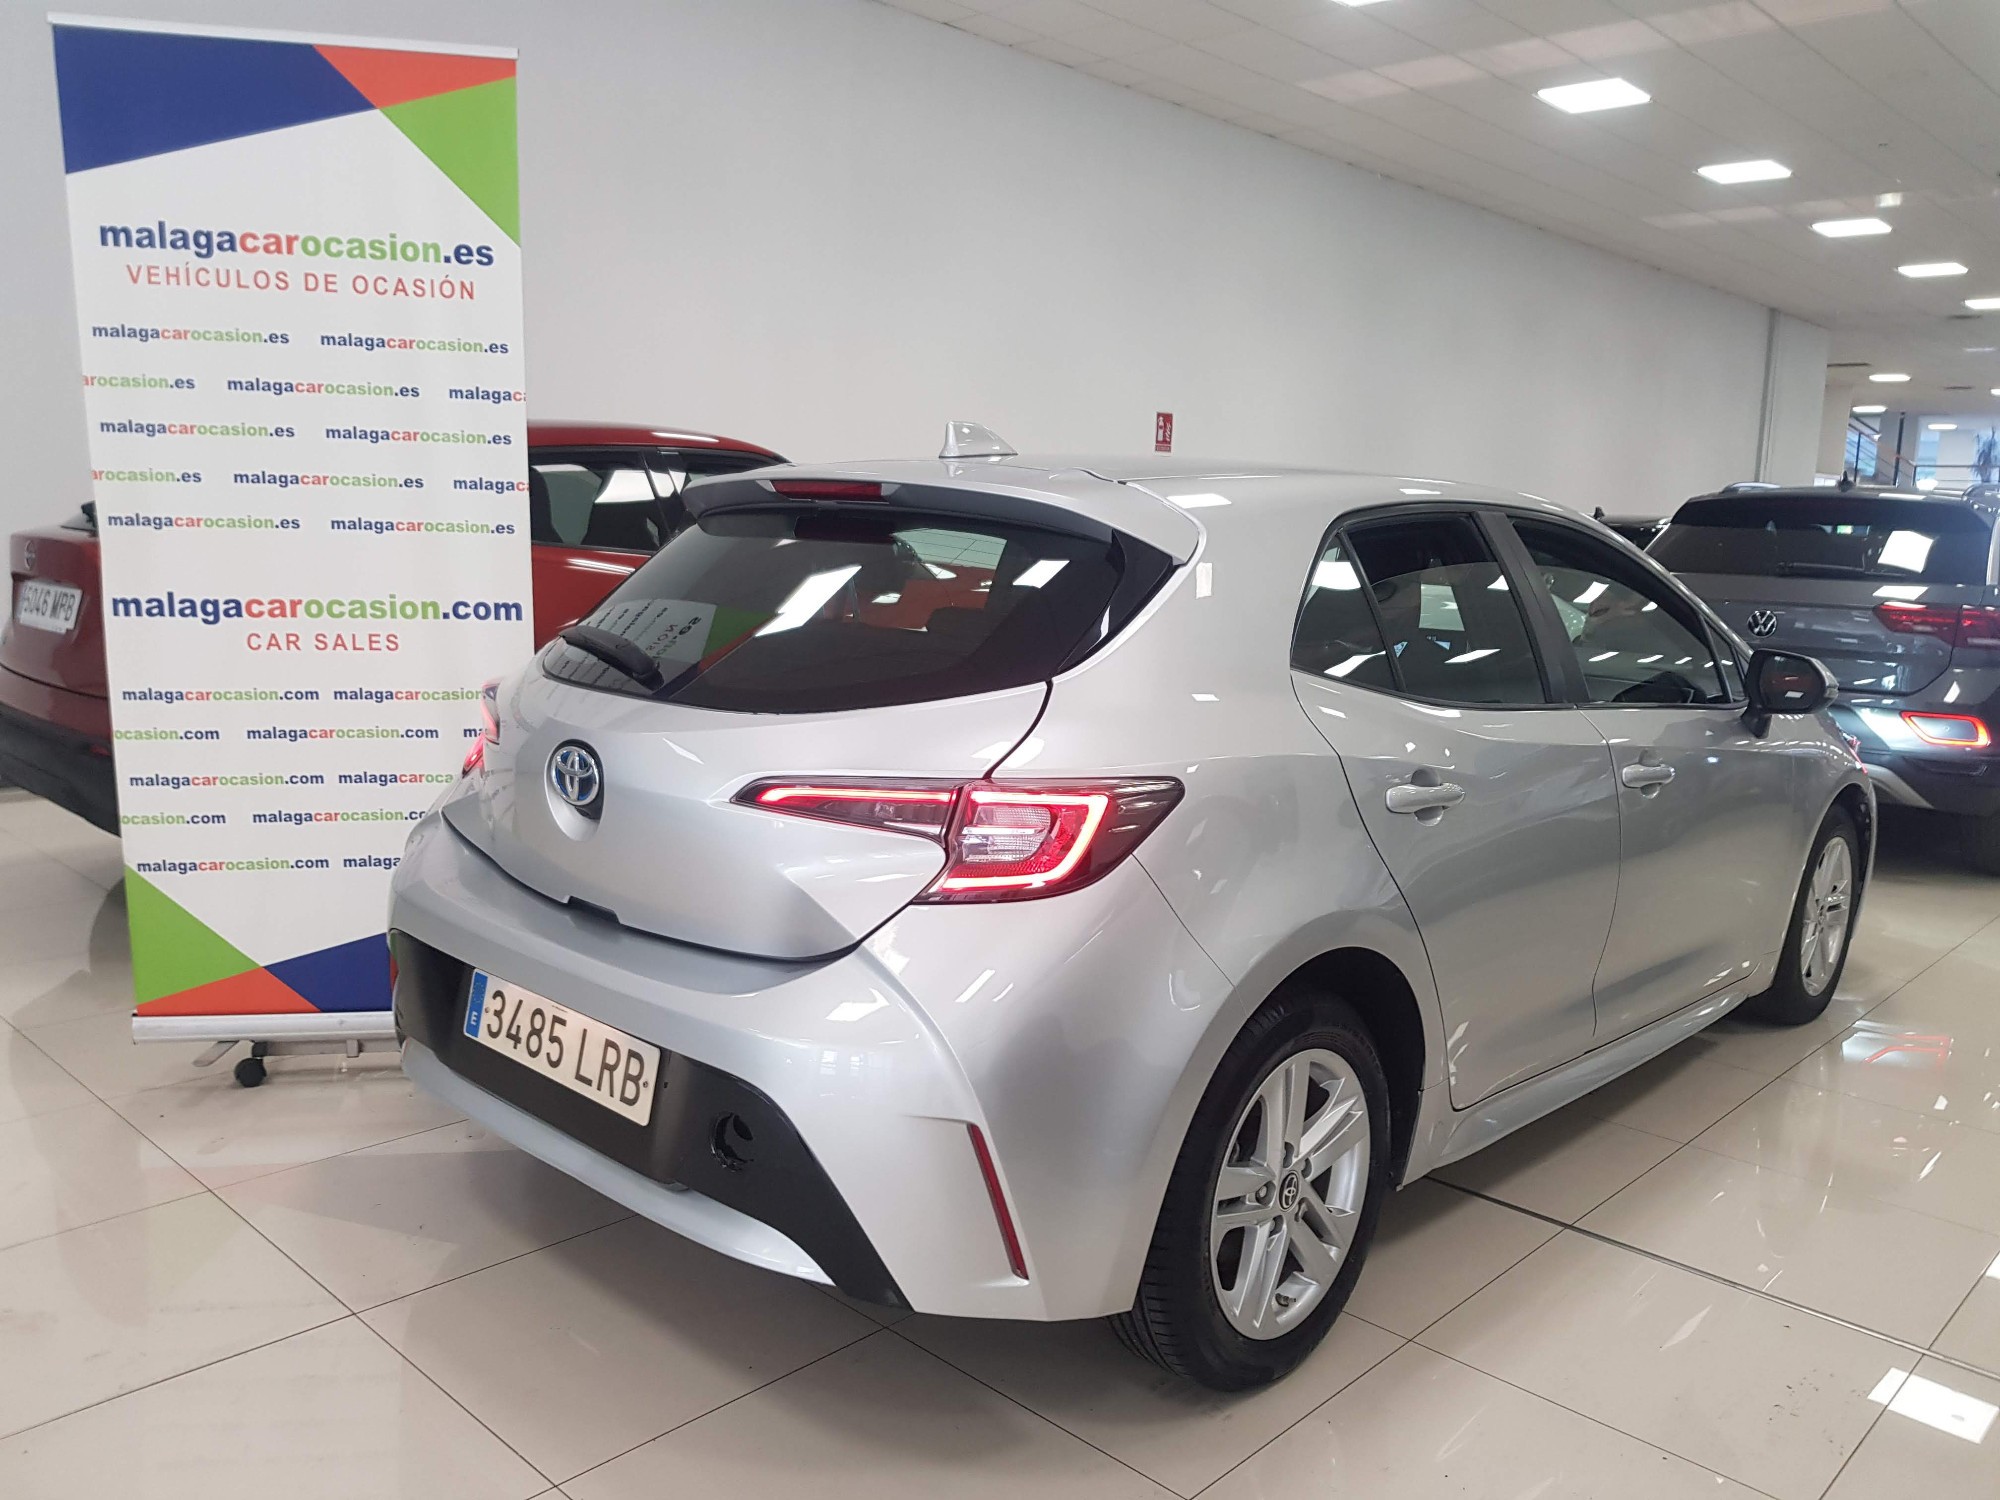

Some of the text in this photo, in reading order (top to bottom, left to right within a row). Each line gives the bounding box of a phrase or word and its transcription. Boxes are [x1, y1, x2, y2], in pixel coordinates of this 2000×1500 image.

[100, 221, 494, 265] malagacarocasion.es
[127, 262, 474, 300] VEHÍCULOS DE OCASIÓN
[92, 324, 289, 344] malagacarocasion.es
[321, 333, 508, 353] malagacarocasion.es
[228, 378, 419, 397] malagacarocasion.es
[449, 386, 526, 404] malagac
[100, 419, 294, 437] malagacarocasion.es
[326, 426, 511, 445] malagacarocasion.es
[234, 471, 424, 488] malagacarocasion.es
[454, 477, 527, 494] malagac
[108, 513, 300, 530] malagacarocasion.es
[331, 517, 515, 534] malagacarocasion.es
[112, 591, 522, 624] malagacarocasion.com
[247, 633, 398, 651] CAR SALES
[123, 688, 319, 704] malagacarocasion.com
[247, 726, 439, 742] malagacarocasion.com
[130, 773, 324, 789] malagacarocasion.com
[137, 858, 329, 874] malagacarocasion.com
[471, 990, 645, 1107] E 3485 LRB
